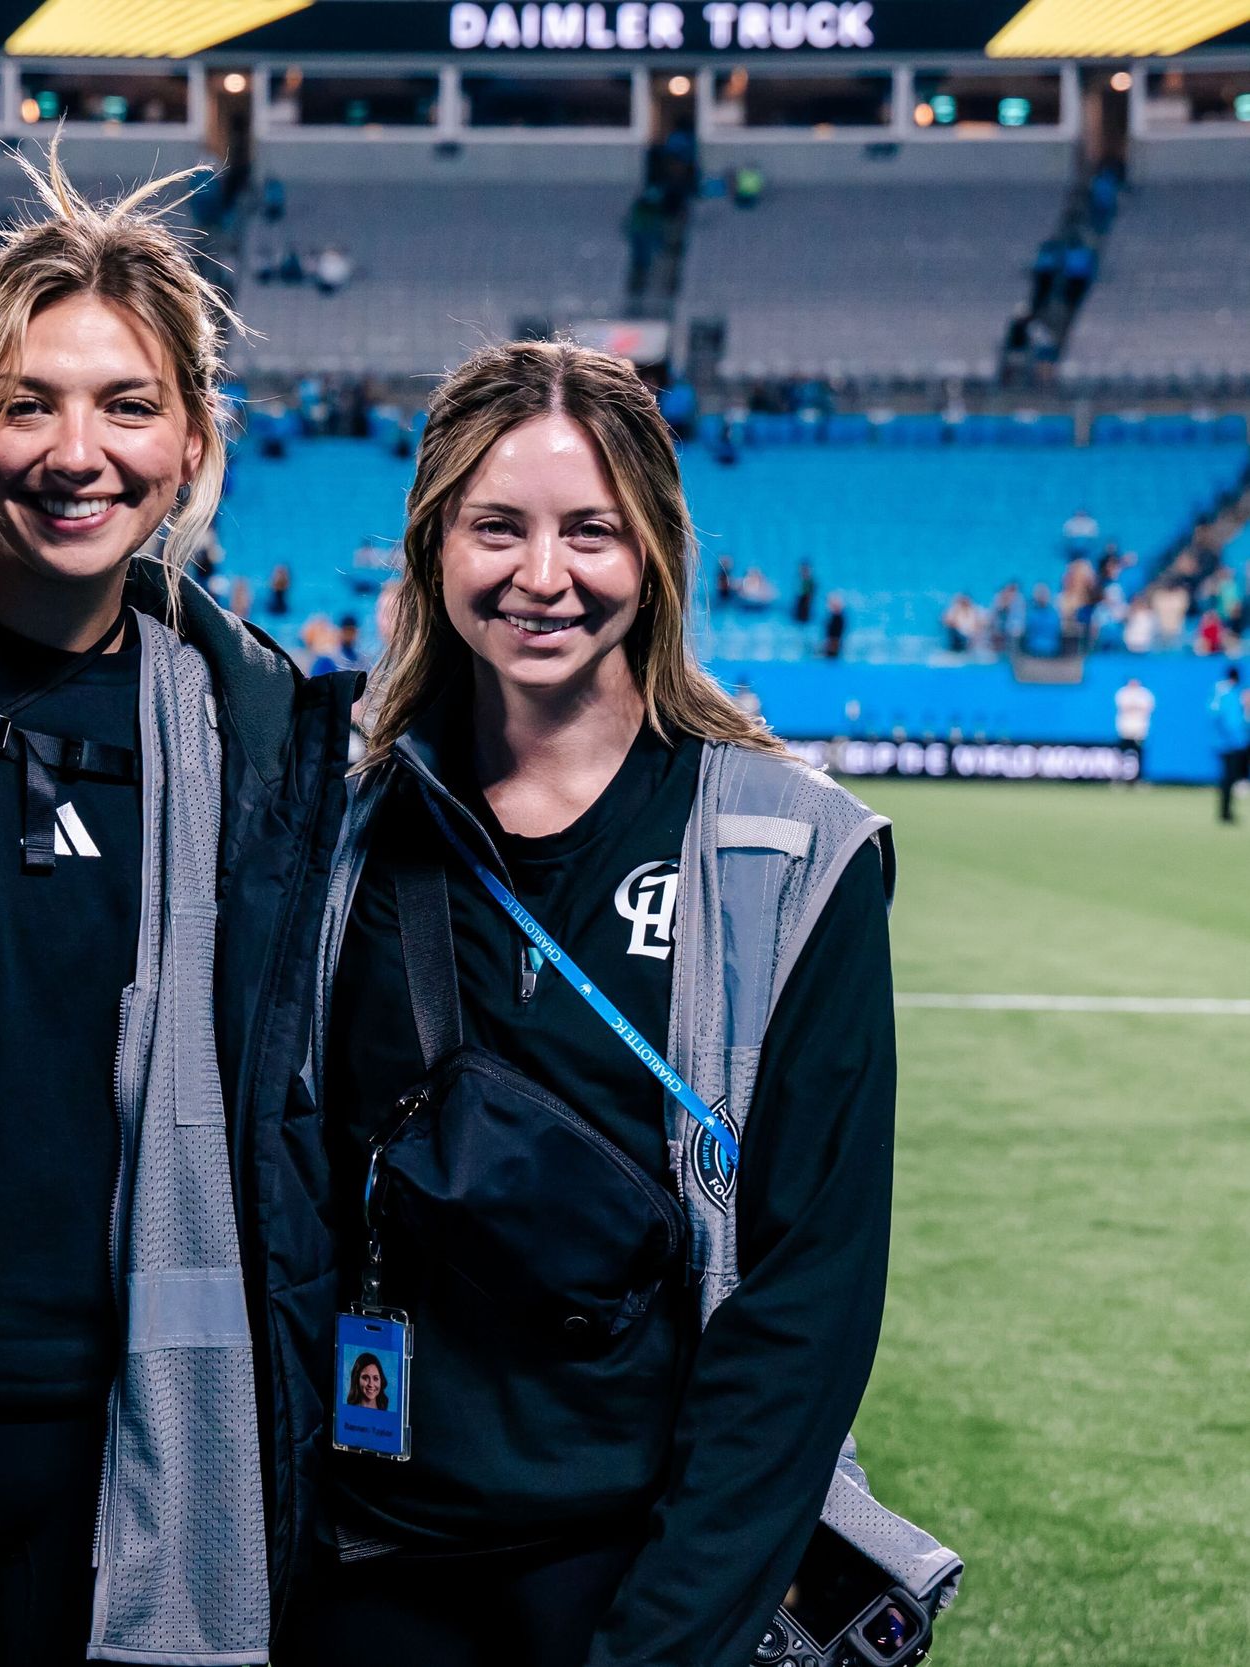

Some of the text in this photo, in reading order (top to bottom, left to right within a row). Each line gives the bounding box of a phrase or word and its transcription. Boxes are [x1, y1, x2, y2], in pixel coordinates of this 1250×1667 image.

[450, 1, 874, 49] DAIMLER TRUCK
[500, 894, 561, 962] CHARLOTTE FC
[611, 1017, 682, 1092] CHARLOTTE FC
[702, 1132, 713, 1170] MINTED
